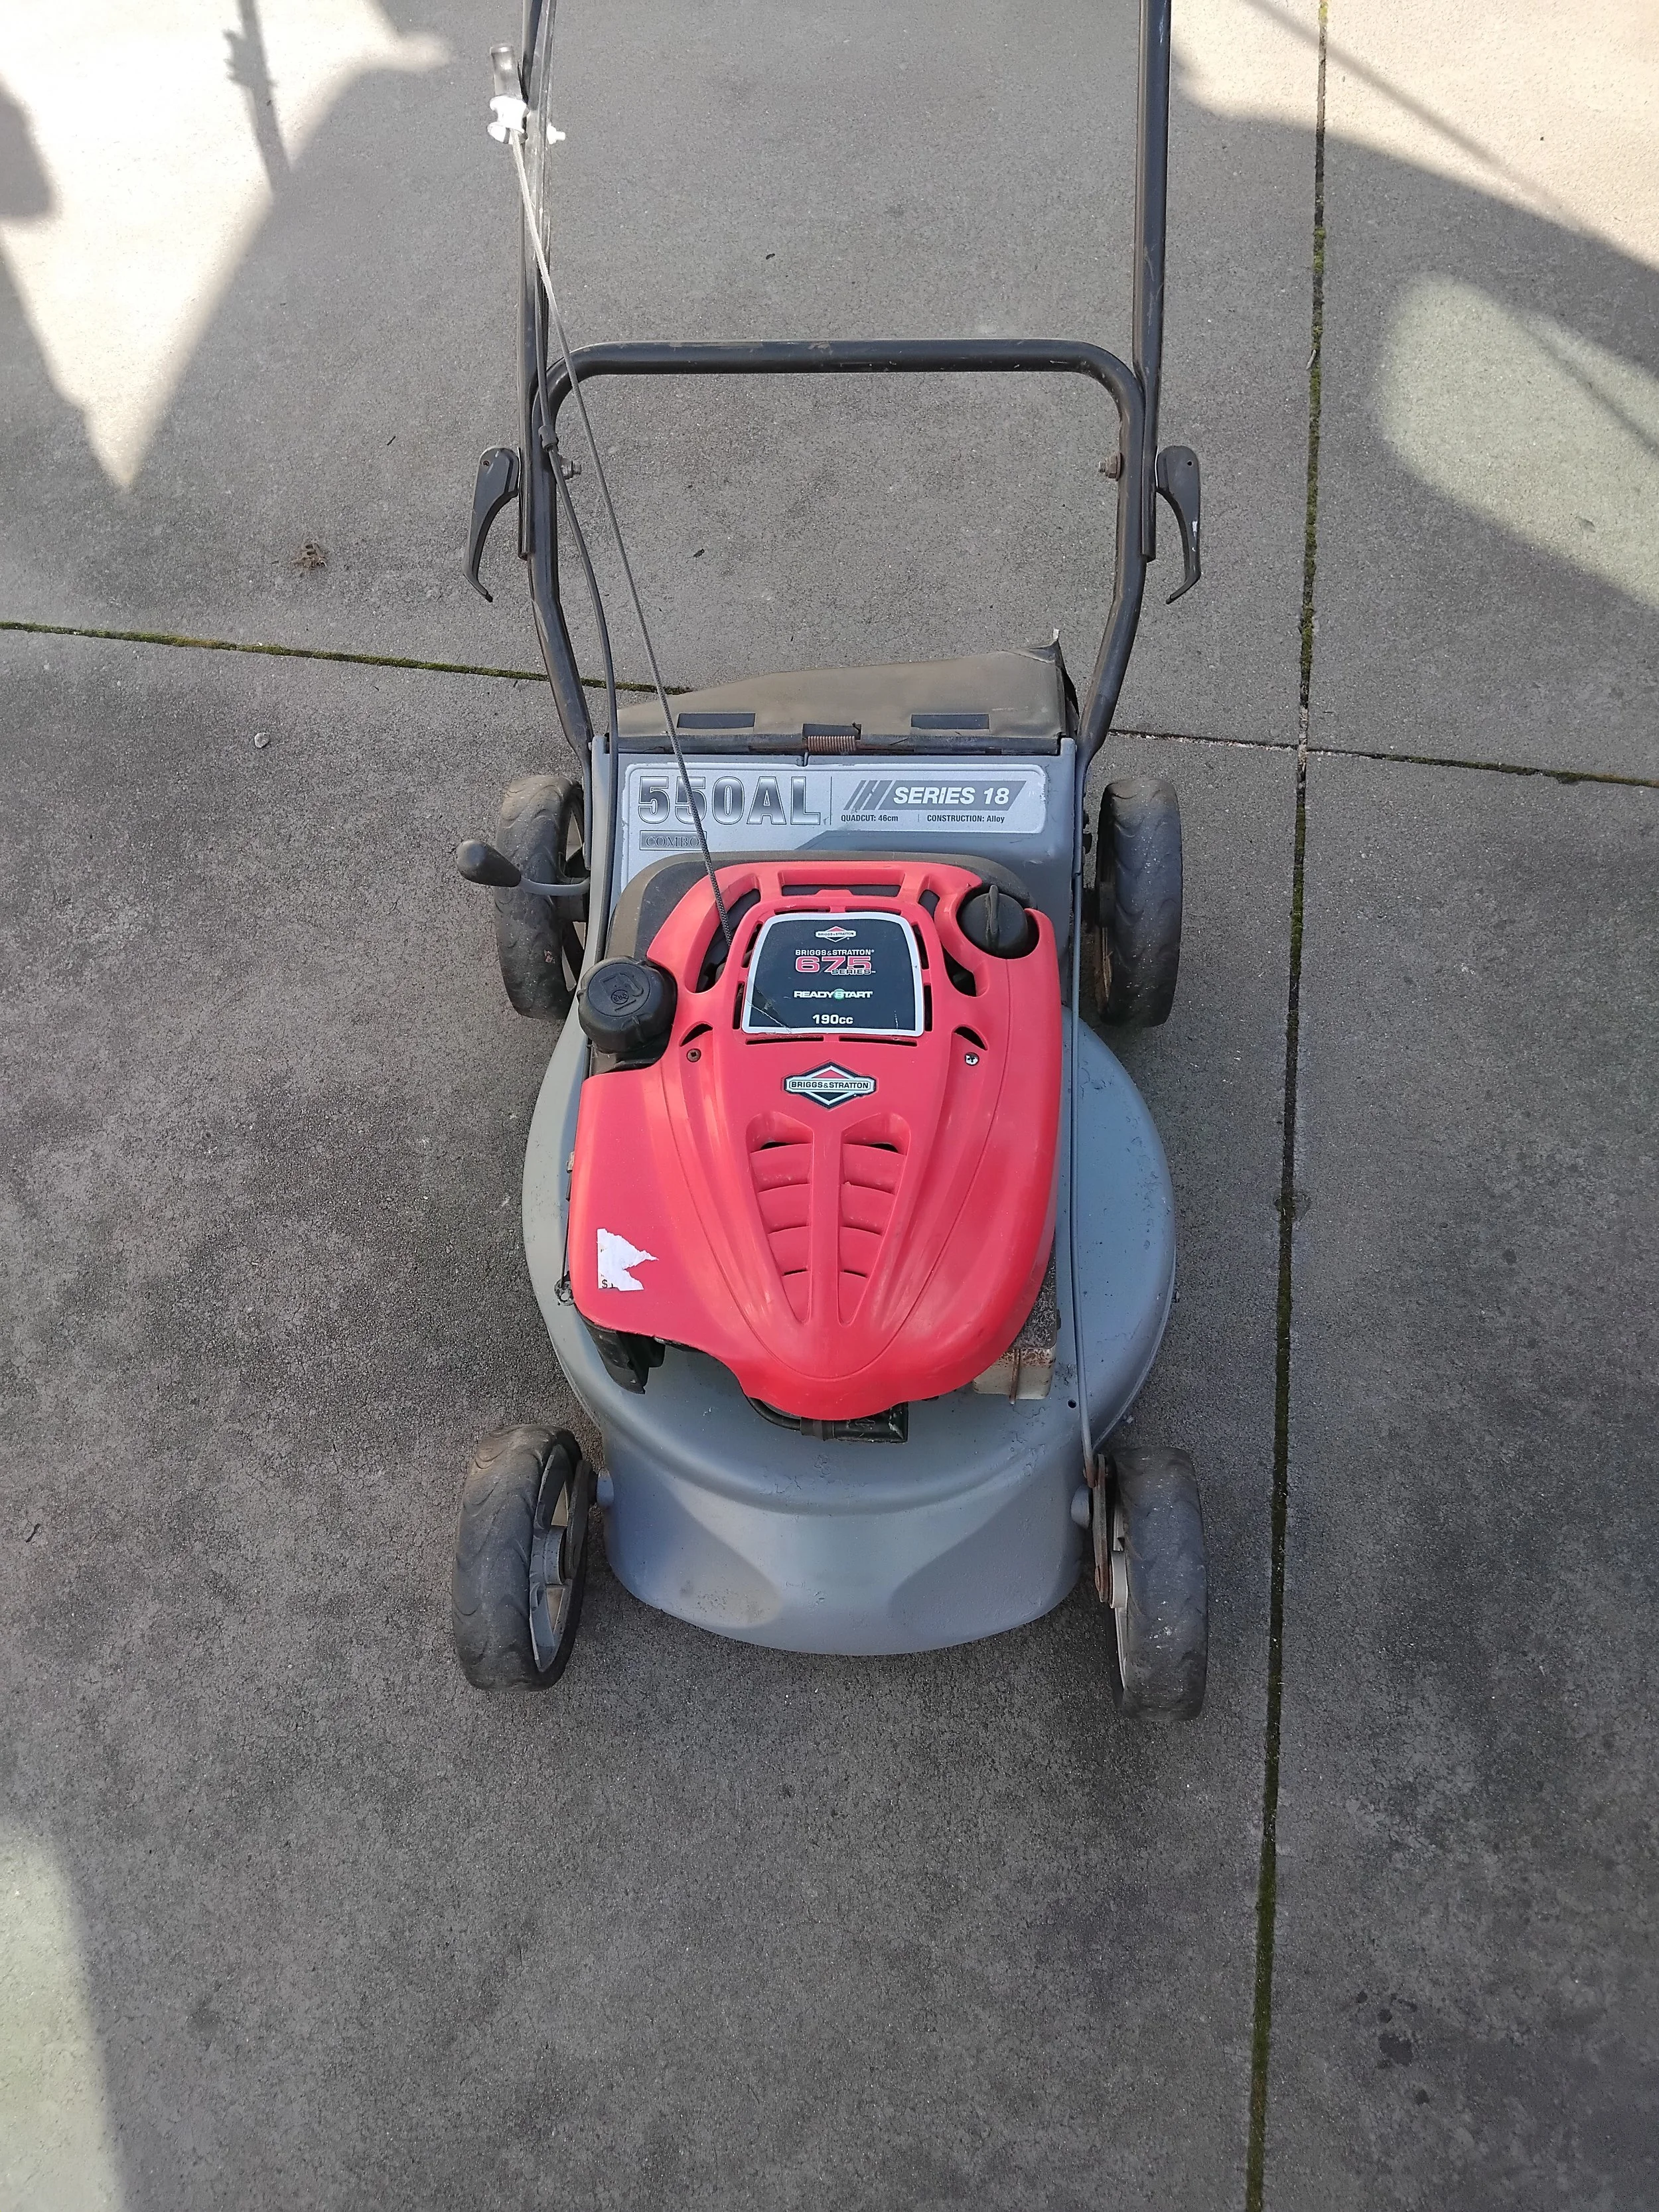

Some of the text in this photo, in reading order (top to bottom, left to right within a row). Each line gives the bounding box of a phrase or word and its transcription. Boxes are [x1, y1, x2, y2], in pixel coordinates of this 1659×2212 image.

[638, 776, 821, 825] 550AL
[893, 786, 1009, 804] SERIES 18
[987, 815, 1005, 824] Alloy
[646, 836, 699, 848] COMBO
[796, 956, 872, 973] 675
[812, 1014, 853, 1024] 190cc
